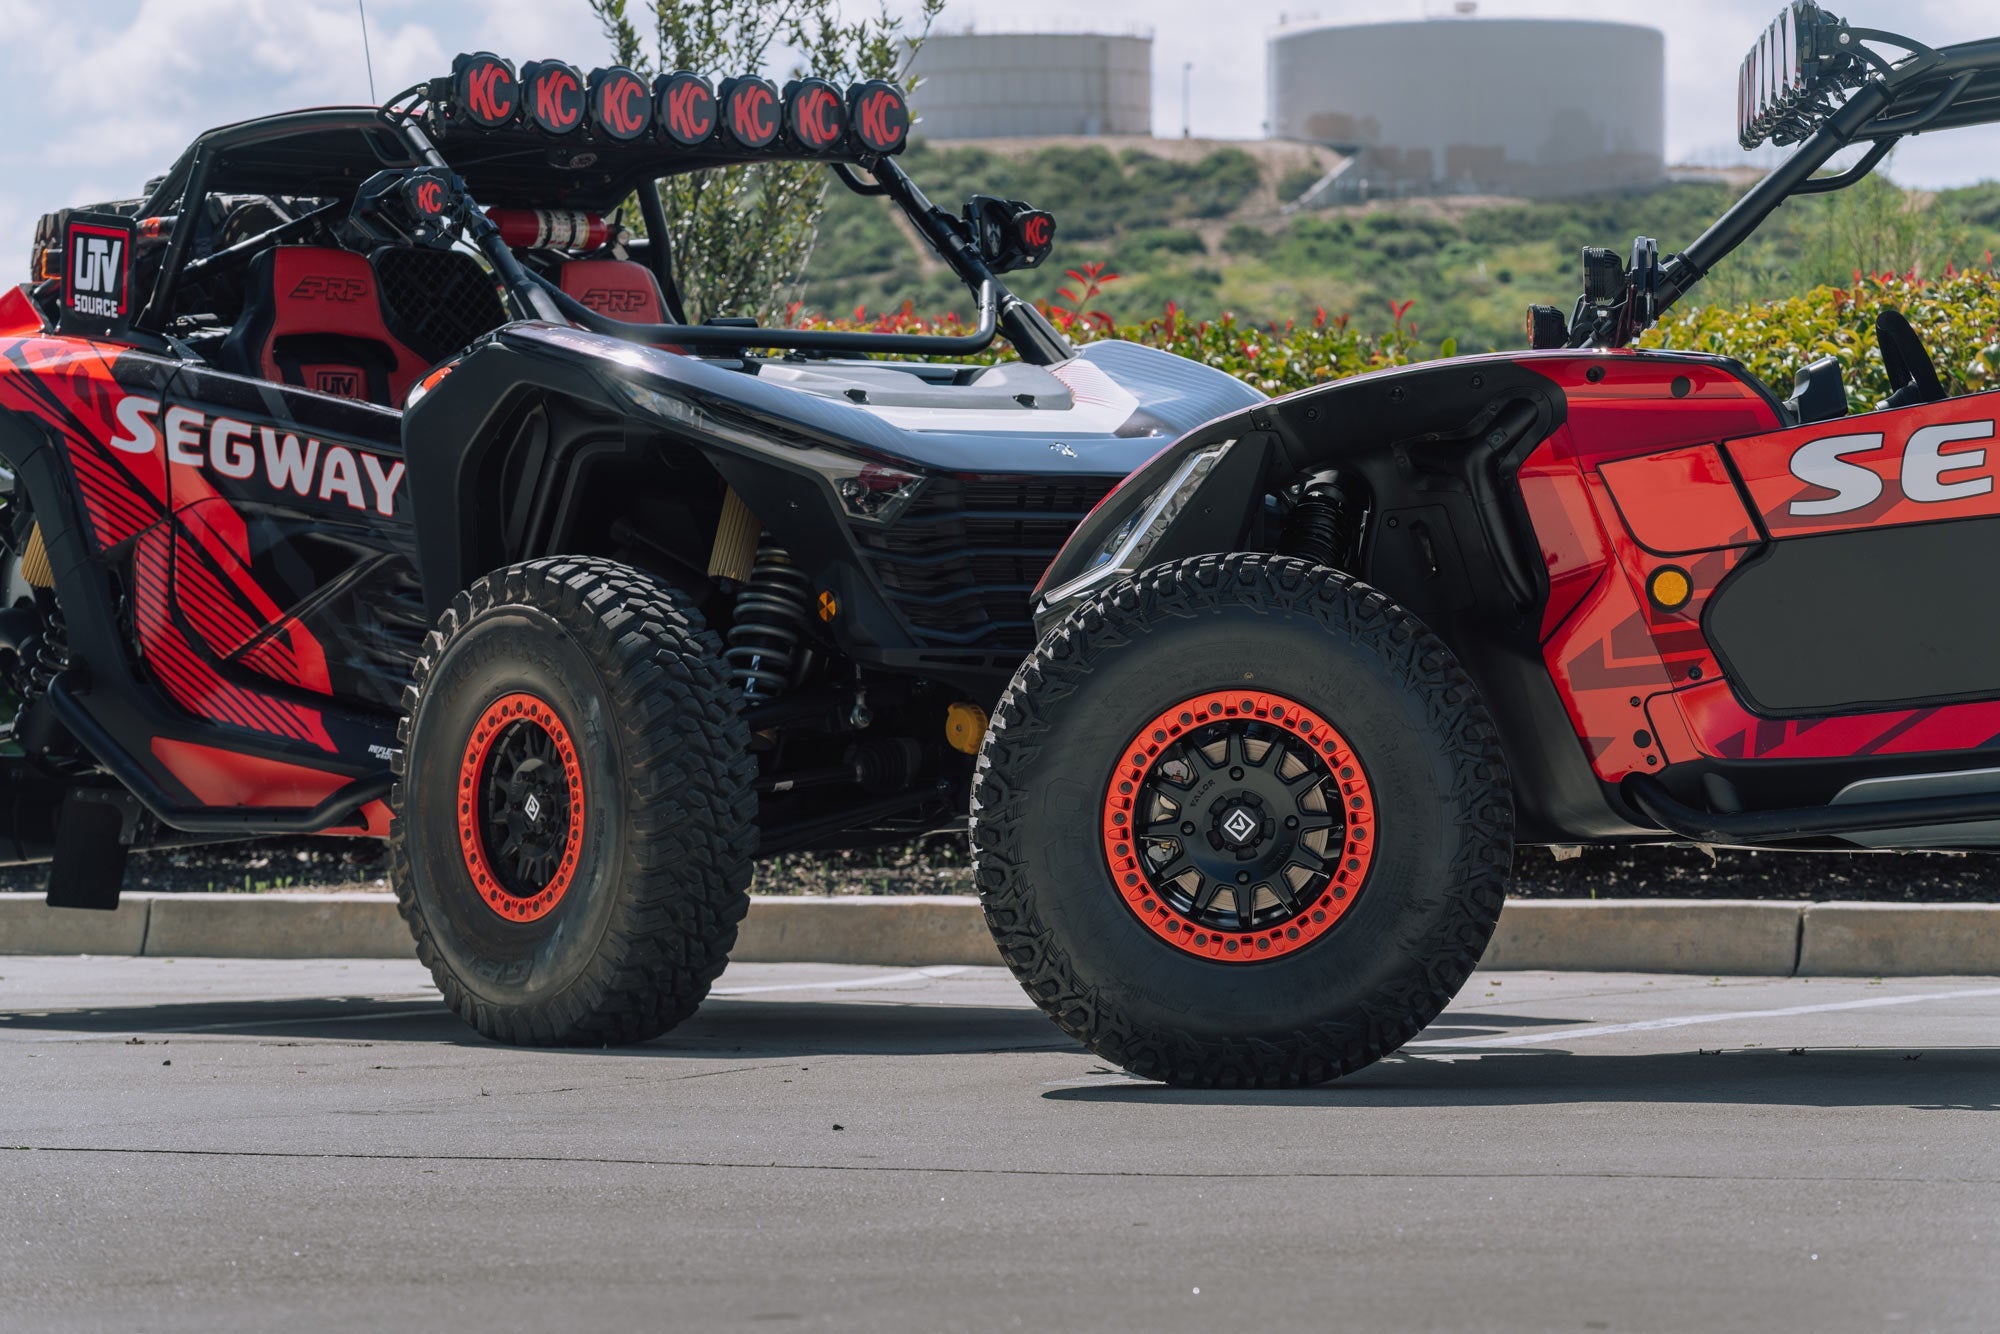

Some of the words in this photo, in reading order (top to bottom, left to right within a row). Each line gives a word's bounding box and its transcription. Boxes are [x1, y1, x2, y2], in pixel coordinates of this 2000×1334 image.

[470, 64, 509, 120] KC
[538, 71, 576, 126] KC
[604, 77, 642, 132] KC
[670, 82, 708, 138] KC
[735, 86, 772, 141] KC
[799, 90, 838, 143] KC
[863, 91, 900, 145] KC
[418, 181, 441, 213] KC
[1026, 217, 1048, 246] KC
[75, 237, 122, 293] UTV
[288, 276, 367, 302] PRP
[74, 294, 118, 318] SOURCE
[580, 288, 646, 312] PRP
[321, 375, 354, 396] UTV
[110, 395, 405, 516] SEGWAY
[1788, 419, 1995, 516] SE
[1189, 778, 1216, 807] VALOR
